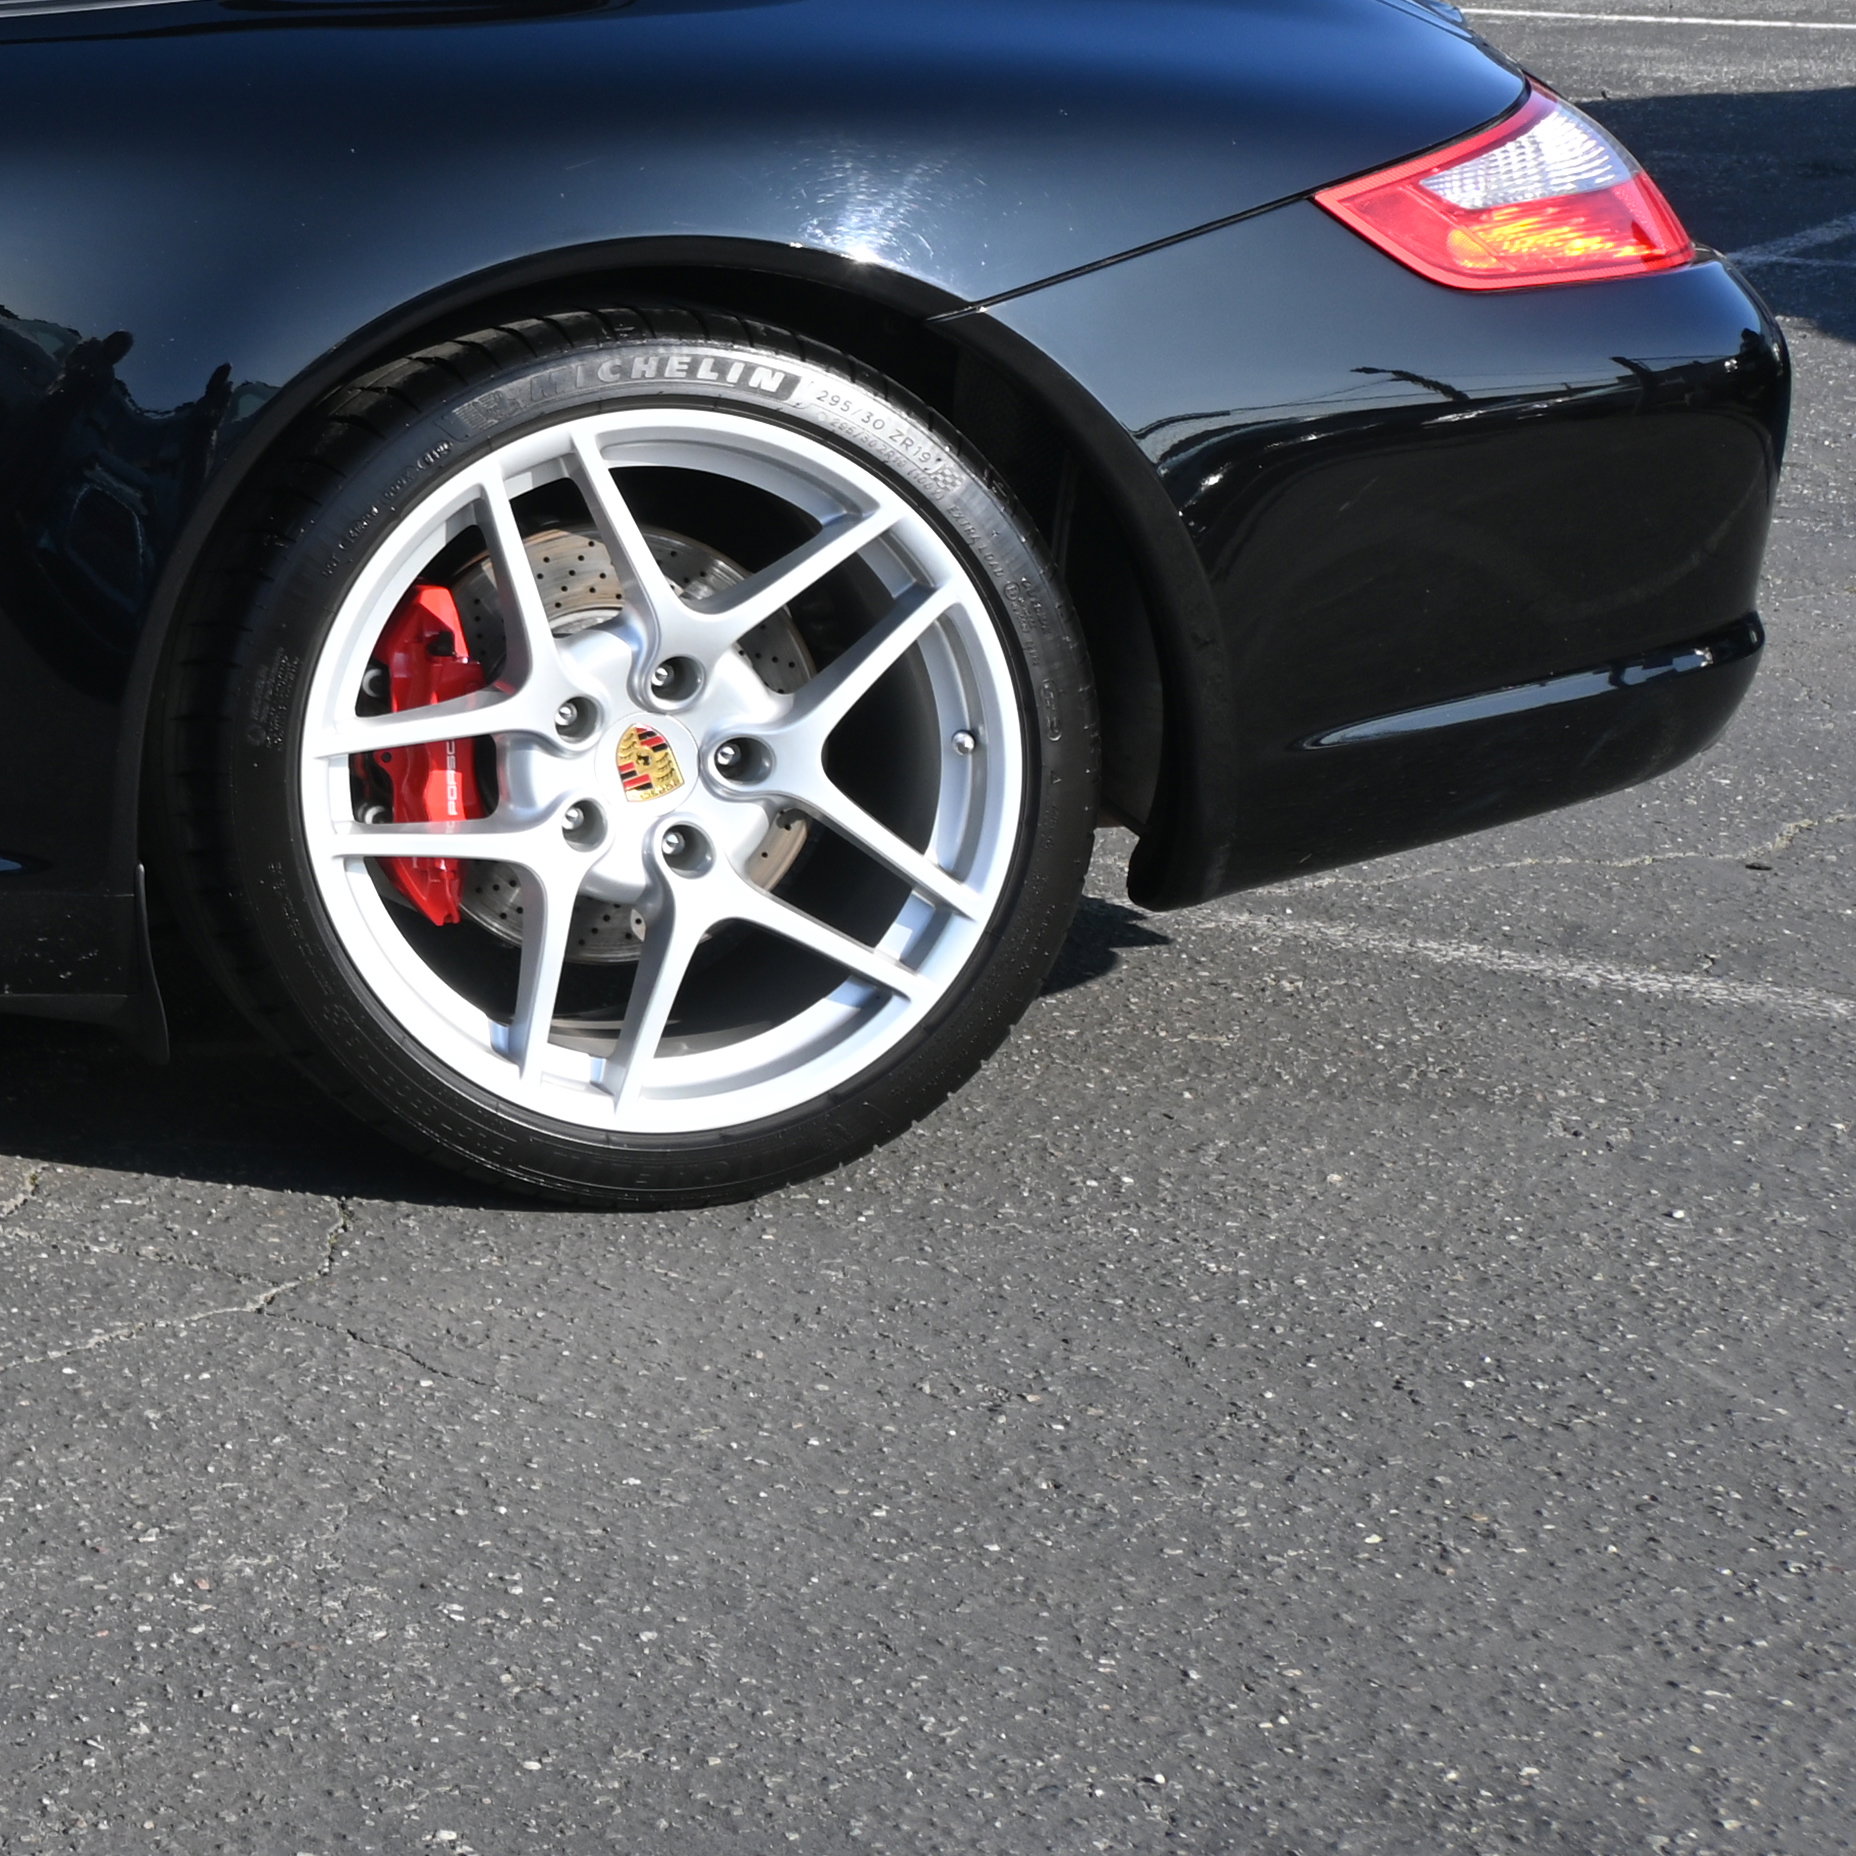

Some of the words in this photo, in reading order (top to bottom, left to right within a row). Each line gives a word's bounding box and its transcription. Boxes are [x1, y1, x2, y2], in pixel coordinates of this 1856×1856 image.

[529, 355, 787, 402] MICHELIN
[816, 389, 886, 431] 295/30
[888, 428, 933, 464] ZR19
